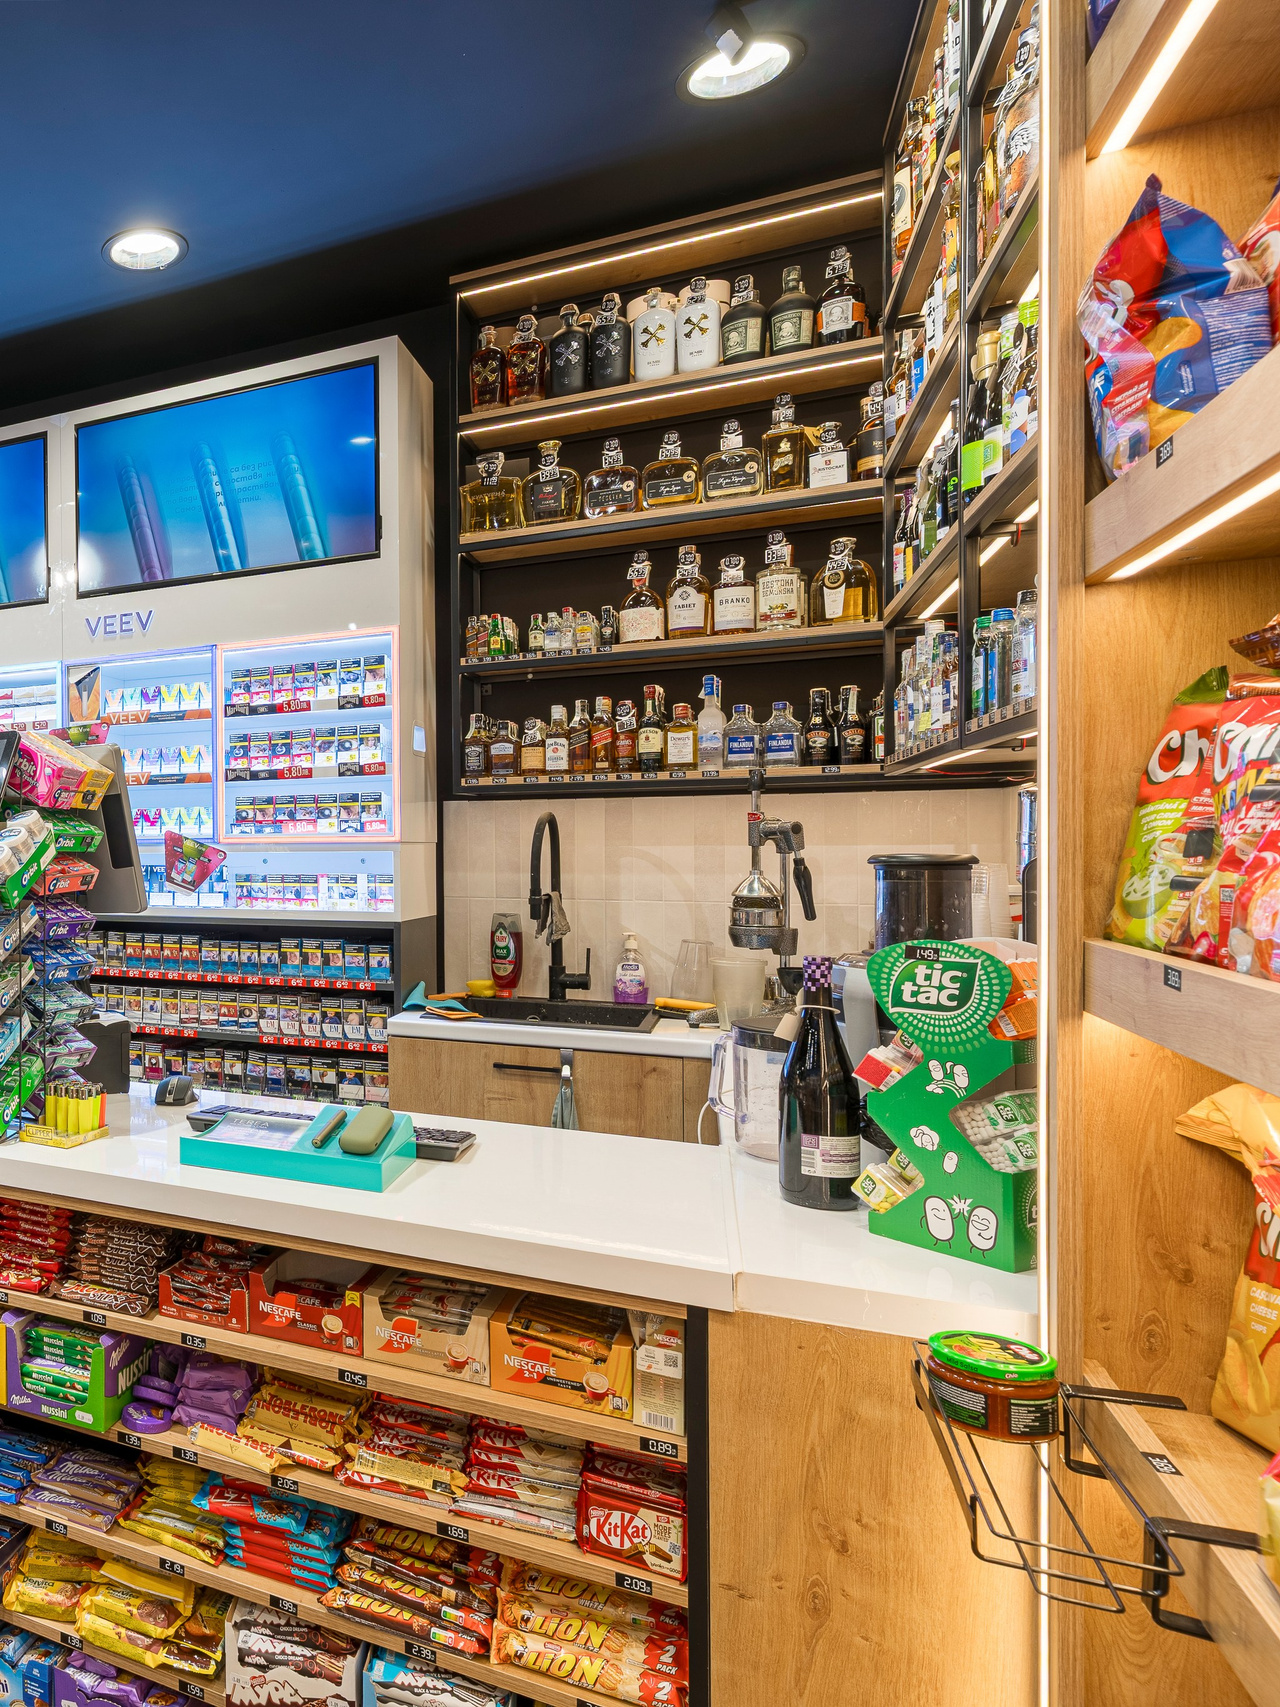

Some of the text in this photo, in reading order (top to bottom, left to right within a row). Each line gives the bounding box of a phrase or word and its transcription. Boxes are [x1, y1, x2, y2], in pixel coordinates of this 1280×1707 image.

[1137, 380, 1148, 392] ЗА
[1111, 388, 1148, 415] СТРАХОТНИ
[812, 463, 845, 474] ARISTOCRAT
[674, 602, 696, 610] TABIET
[719, 597, 750, 606] BRANKO
[85, 610, 154, 637] VEEV
[110, 711, 148, 725] VEEV
[807, 730, 829, 738] BAILEYS
[843, 728, 865, 737] BAILEYS
[729, 740, 754, 749] FINLANDIA
[769, 739, 792, 747] FINLANDIA
[1142, 813, 1155, 824] SOUR
[1149, 820, 1174, 828] ONION
[1142, 831, 1162, 842] CHIPS
[917, 949, 934, 960] 1.49
[915, 964, 962, 988] tic
[901, 984, 959, 1006] tac
[27, 1128, 52, 1138] CLIPPER
[1250, 1303, 1278, 1320] CHEESE
[90, 1314, 103, 1325] 1.09
[1251, 1322, 1267, 1334] CHIPS
[186, 1336, 202, 1348] 0.35
[109, 1338, 130, 1370] Milka
[946, 1357, 978, 1372] Mild Salsa
[344, 1372, 362, 1386] 0.45
[10, 1394, 32, 1405] Milka
[41, 1404, 68, 1419] Nussini
[269, 1392, 346, 1423] TOBLERONE
[126, 1434, 138, 1445] 1.39
[483, 1428, 528, 1447] KitKat
[649, 1440, 672, 1454] 0.89
[181, 1449, 194, 1461] 1.39
[59, 1460, 100, 1476] Milka
[600, 1461, 656, 1479] KitKat
[277, 1478, 294, 1490] 2.05
[477, 1471, 521, 1488] KitKat
[36, 1490, 74, 1505] Milka
[53, 1522, 64, 1534] 1.59
[448, 1526, 464, 1539] 1.69
[596, 1512, 648, 1548] KitKat
[653, 1523, 672, 1534] MORE
[654, 1530, 671, 1538] TREES
[374, 1527, 444, 1556] LION
[482, 1552, 498, 1567] 2
[165, 1560, 180, 1574] 2.19
[477, 1566, 496, 1577] PACK
[539, 1574, 613, 1604] LION
[624, 1577, 646, 1592] 2.09
[279, 1600, 293, 1612] 1.99
[578, 1599, 605, 1611] WHITE
[660, 1616, 680, 1626] PACK
[531, 1616, 609, 1650] LION
[68, 1635, 80, 1648] 1.39
[412, 1645, 430, 1660] 2.39
[659, 1646, 676, 1664] 2
[525, 1652, 608, 1687] LION
[656, 1664, 678, 1675] PACK
[187, 1684, 200, 1697] 1.59
[654, 1682, 672, 1700] 2
